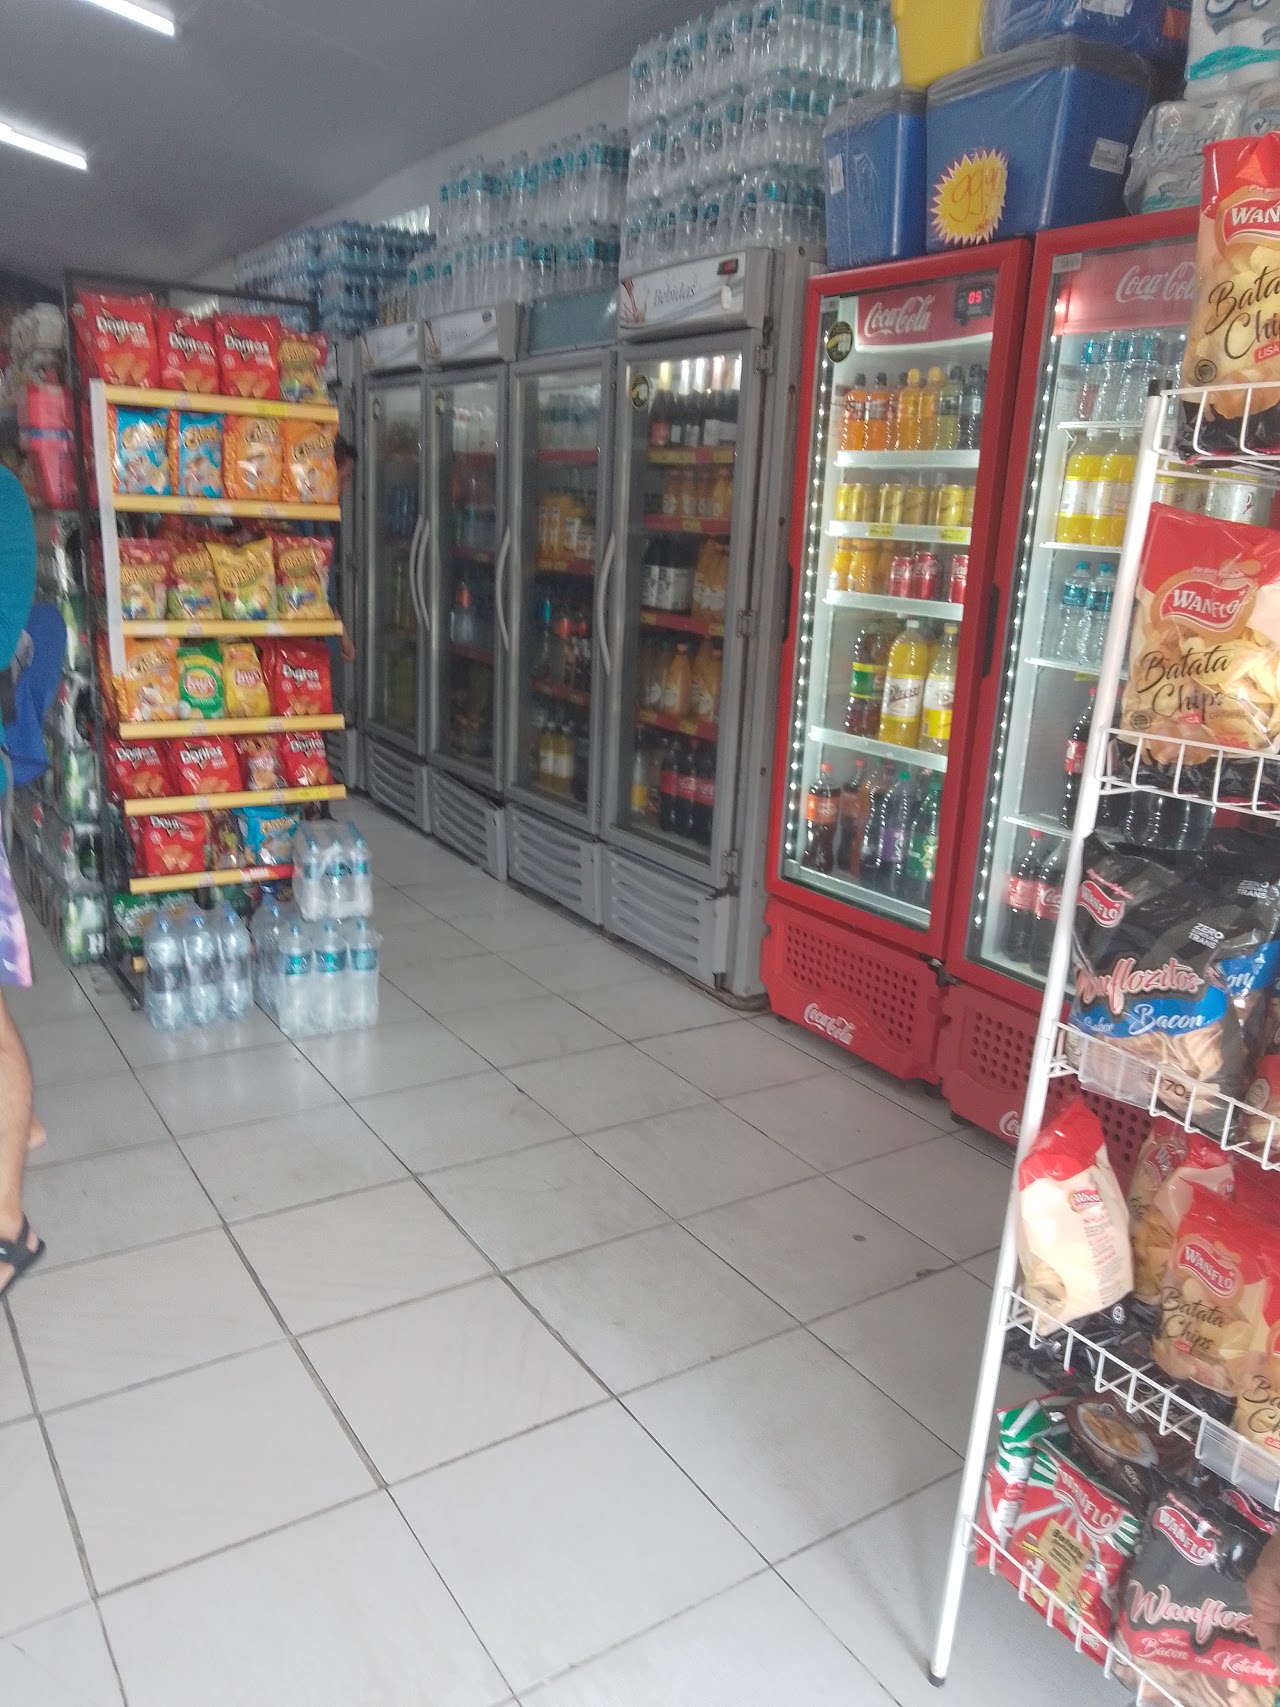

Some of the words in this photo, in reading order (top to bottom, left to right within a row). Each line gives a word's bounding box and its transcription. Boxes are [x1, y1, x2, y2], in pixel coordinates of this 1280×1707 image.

[1137, 645, 1231, 694] Batata
[1188, 932, 1217, 950] TRANS
[1193, 922, 1225, 940] ZERO
[1128, 1004, 1206, 1035] Bacon
[1159, 1509, 1209, 1558] WANFLO
